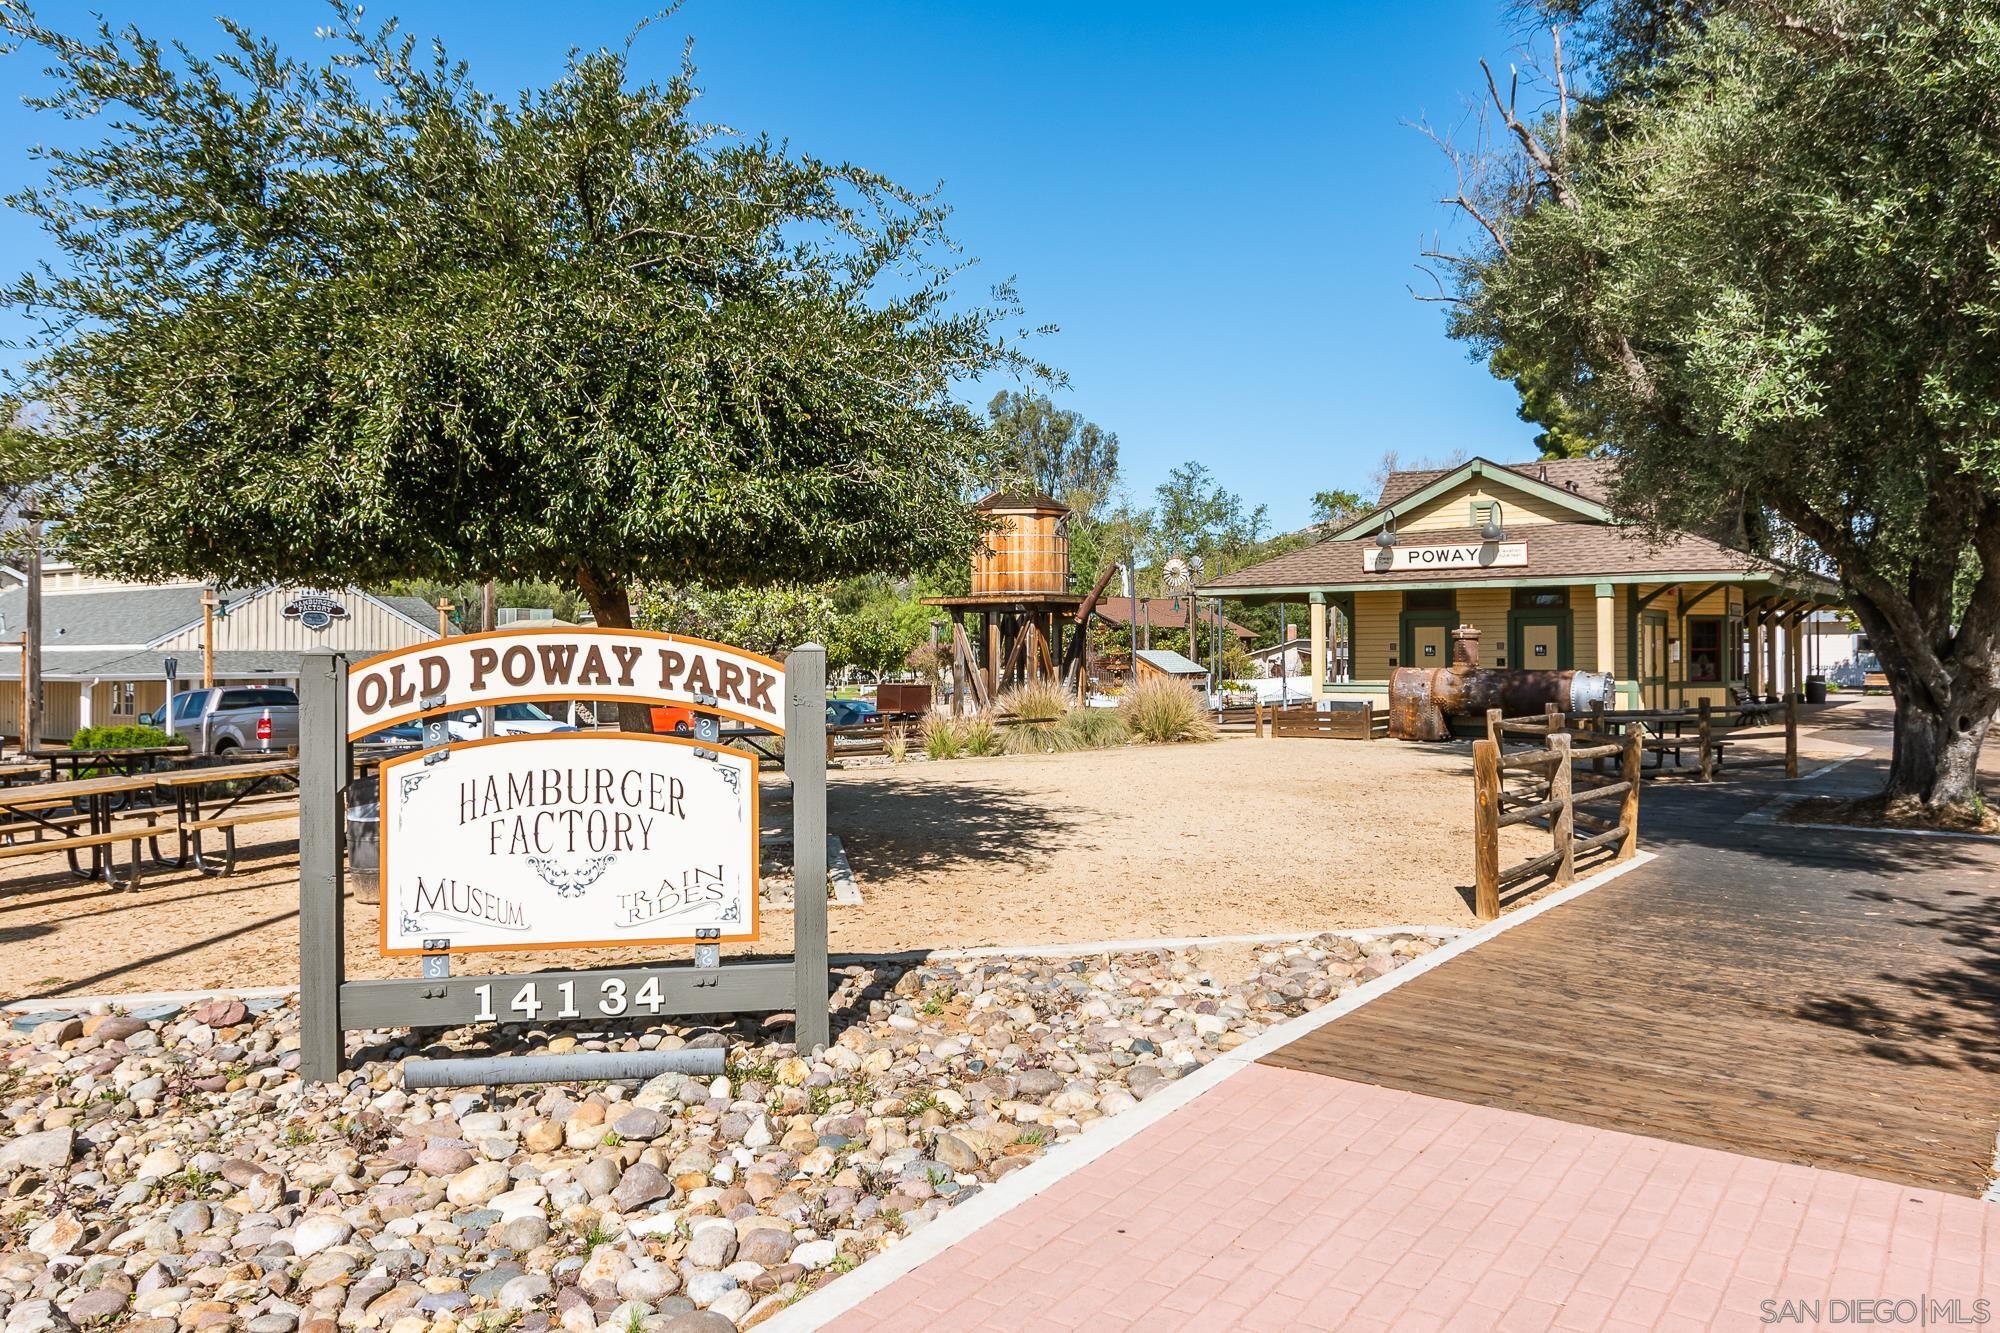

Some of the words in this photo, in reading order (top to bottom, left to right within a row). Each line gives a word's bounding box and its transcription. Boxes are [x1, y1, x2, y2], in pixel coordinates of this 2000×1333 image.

[1408, 547, 1479, 563] POWAY
[292, 599, 337, 608] HAMBURGER
[357, 655, 450, 715] OLD
[470, 644, 642, 691] POWAY
[658, 648, 776, 714] PARK
[459, 768, 686, 825] HAMBURGER
[489, 809, 653, 855] FACTORY
[414, 876, 524, 926] MUSEUM
[616, 864, 723, 909] TRAIN
[629, 883, 724, 923] RIDES
[474, 976, 666, 1022] 14134
